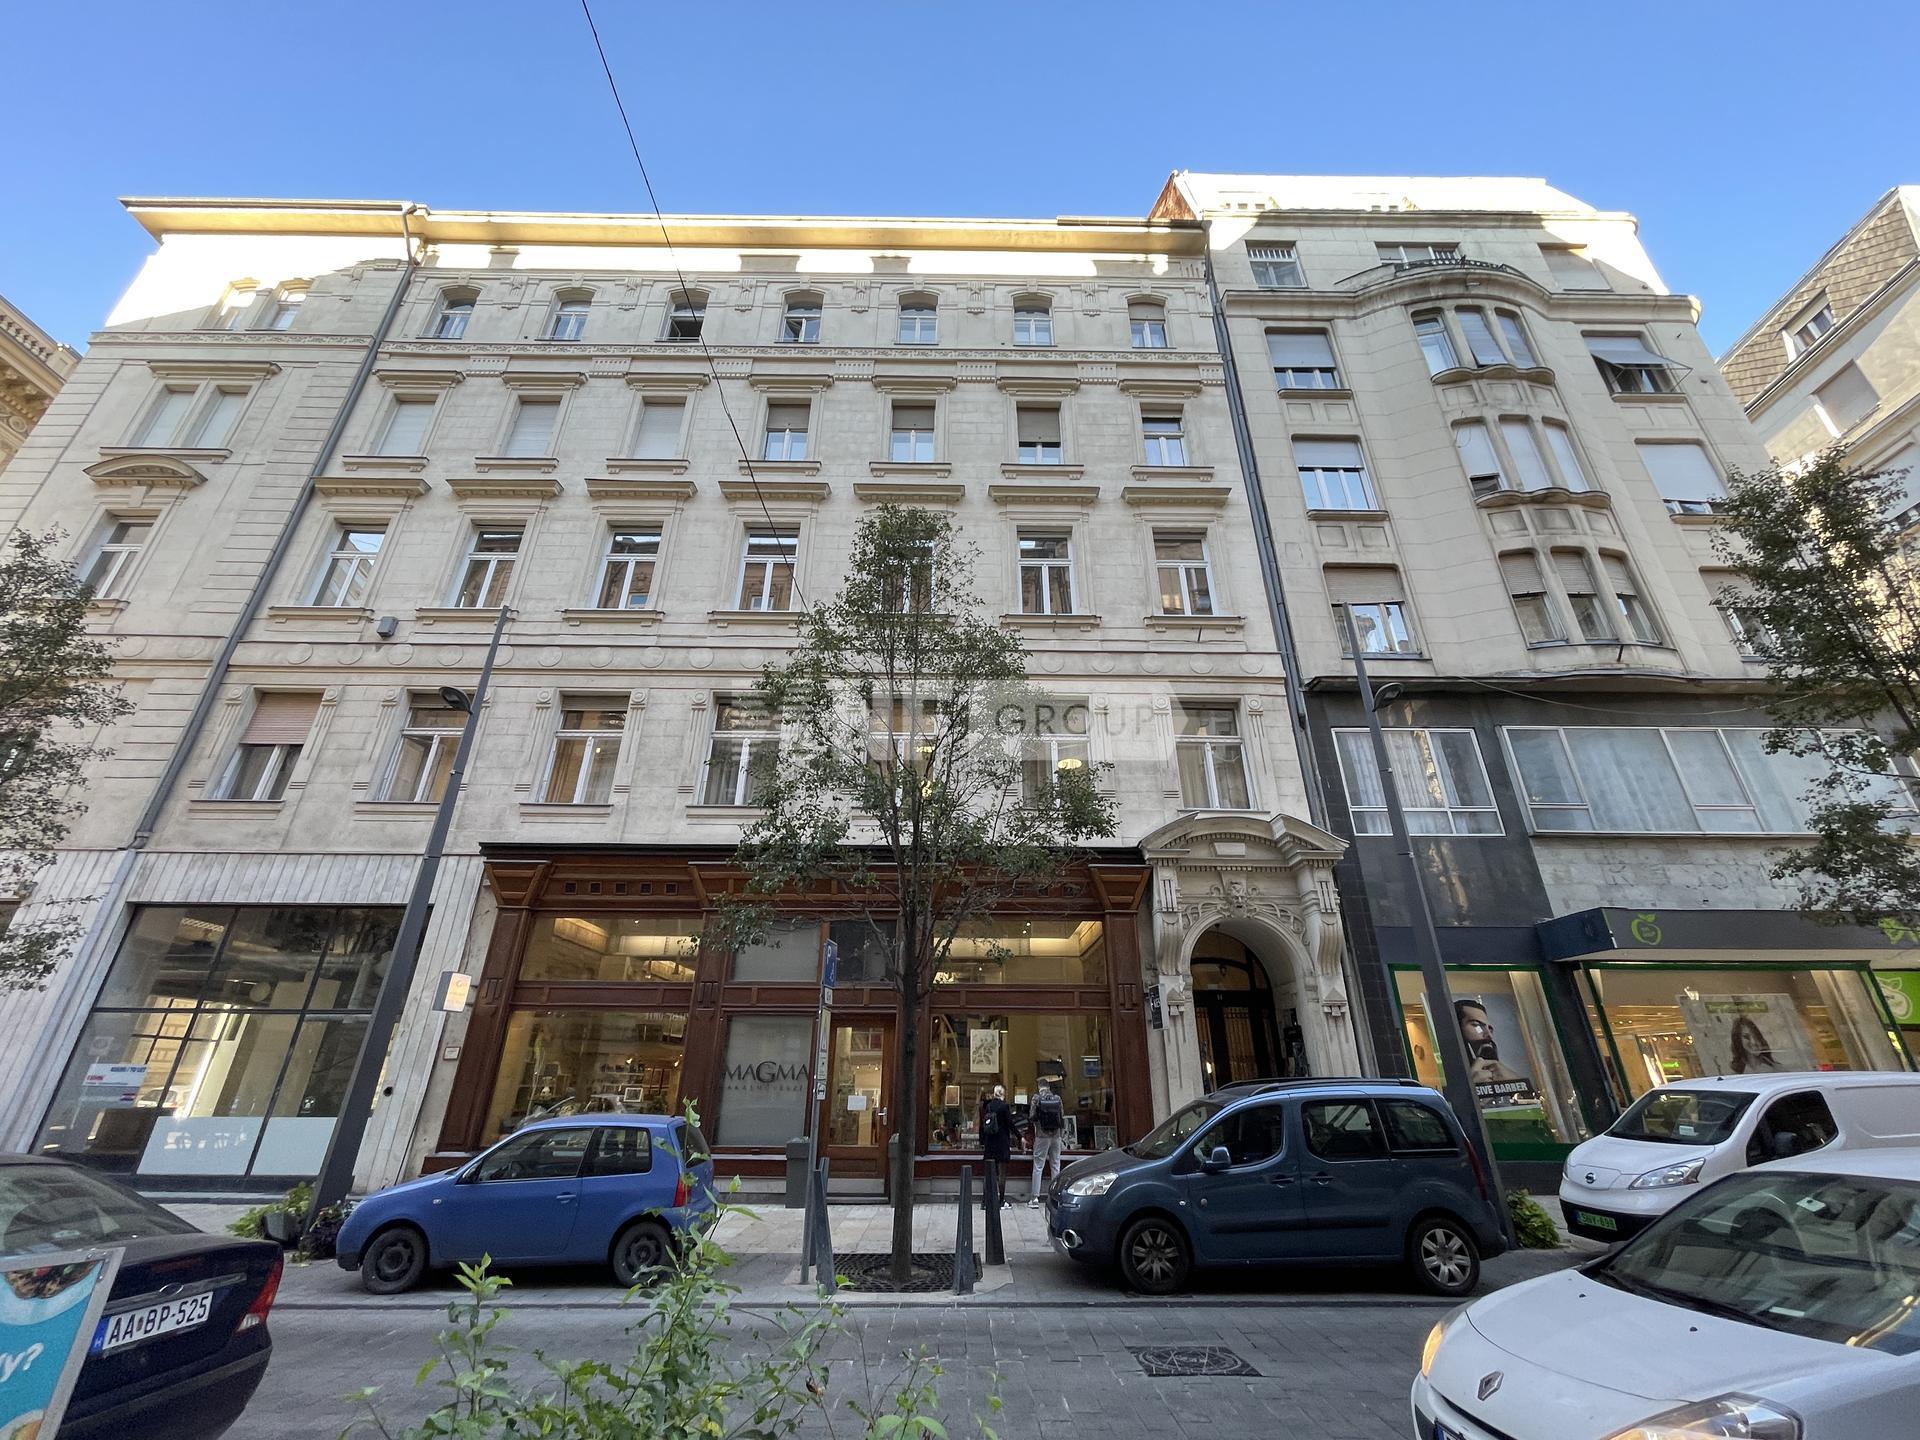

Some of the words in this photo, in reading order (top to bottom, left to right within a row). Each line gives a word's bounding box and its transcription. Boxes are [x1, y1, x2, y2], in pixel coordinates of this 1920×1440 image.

[721, 1061, 808, 1083] MAGMA
[1475, 1085, 1494, 1096] SIVE
[1494, 1082, 1528, 1094] BARBER
